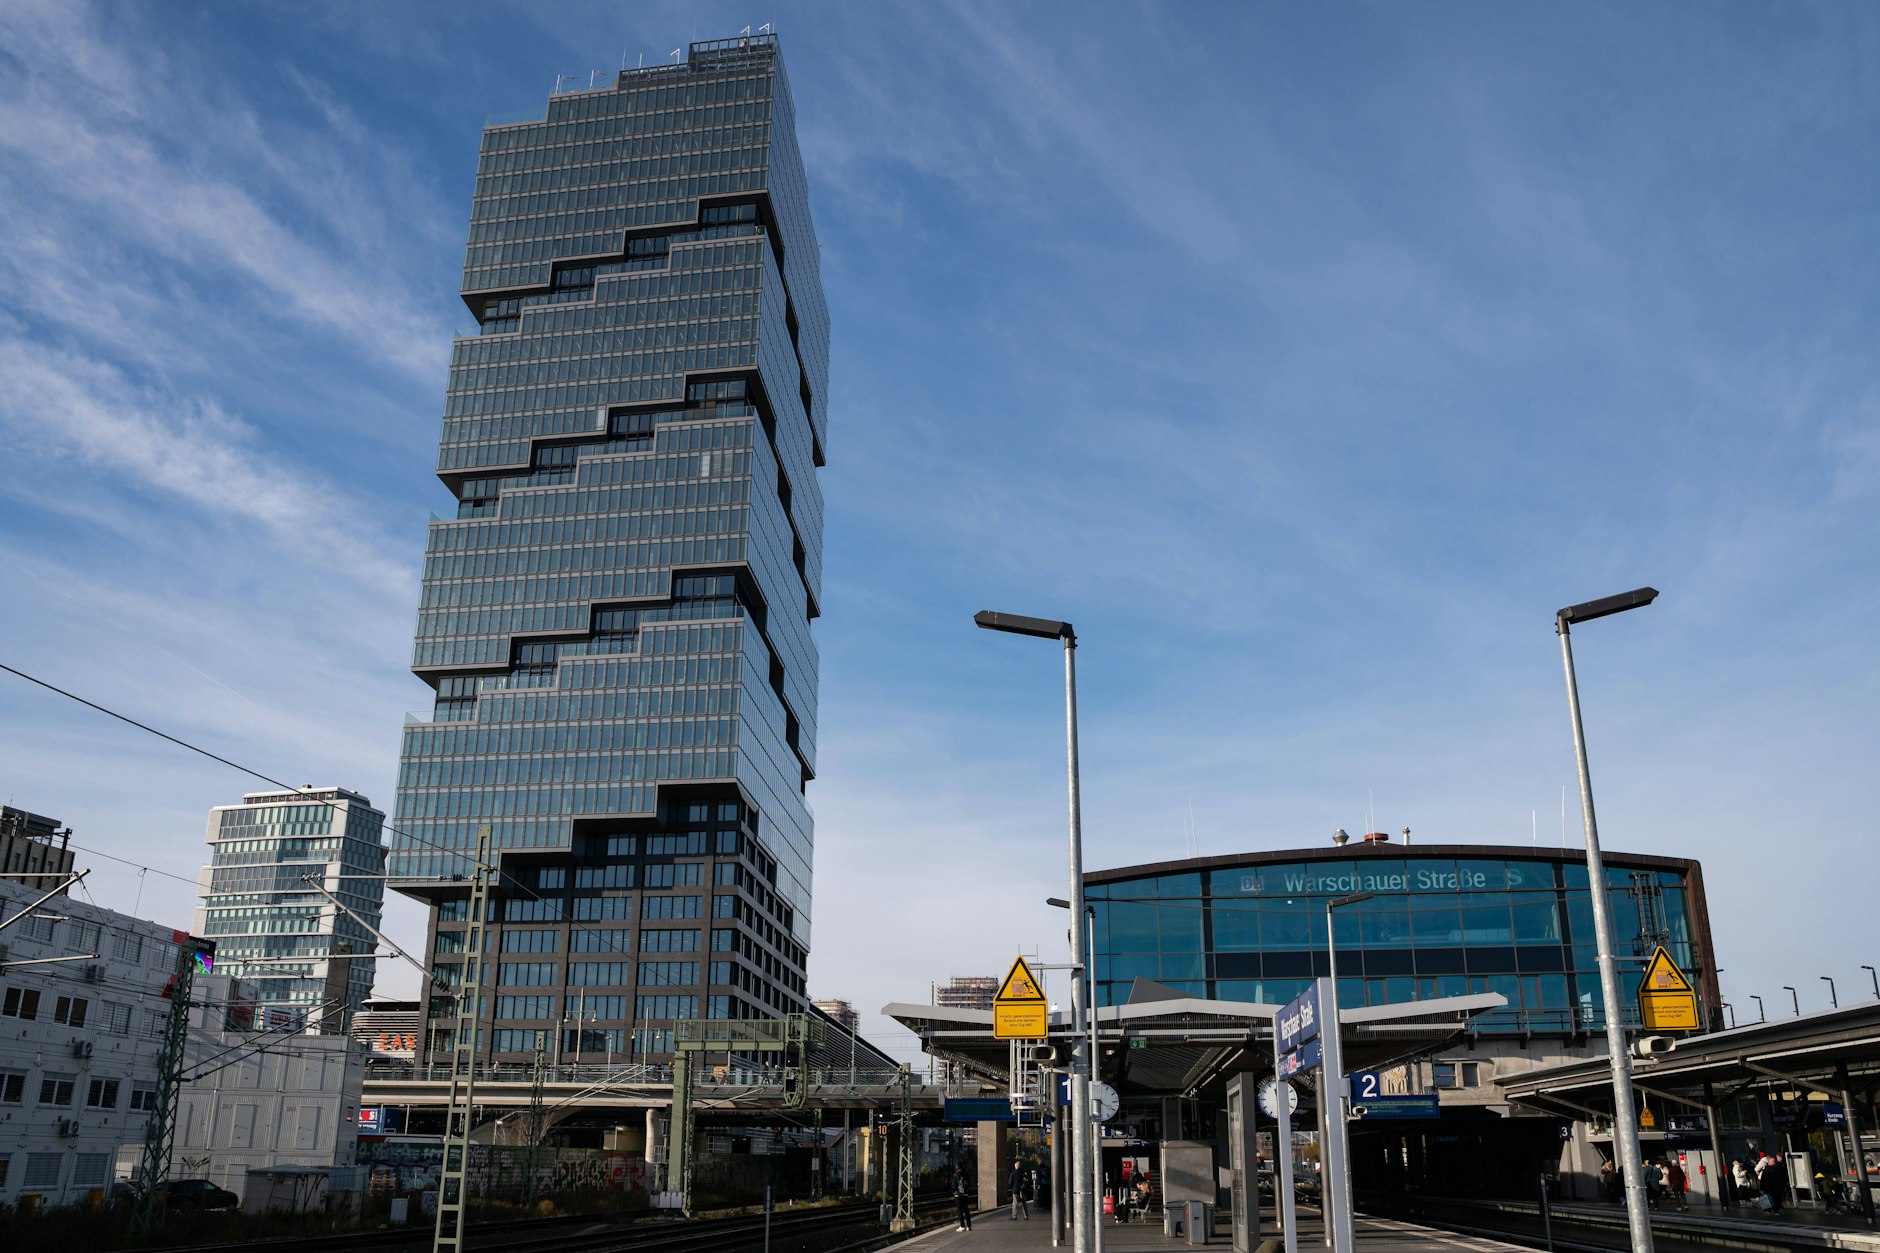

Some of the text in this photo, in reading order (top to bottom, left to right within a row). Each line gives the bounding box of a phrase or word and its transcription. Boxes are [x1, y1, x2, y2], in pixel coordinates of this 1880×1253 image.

[1284, 871, 1410, 892] Warschauer
[1417, 868, 1486, 890] Straße
[1062, 1078, 1072, 1101] 1
[1361, 1074, 1377, 1098] 2
[878, 1124, 888, 1135] 10
[1561, 1126, 1569, 1137] 3
